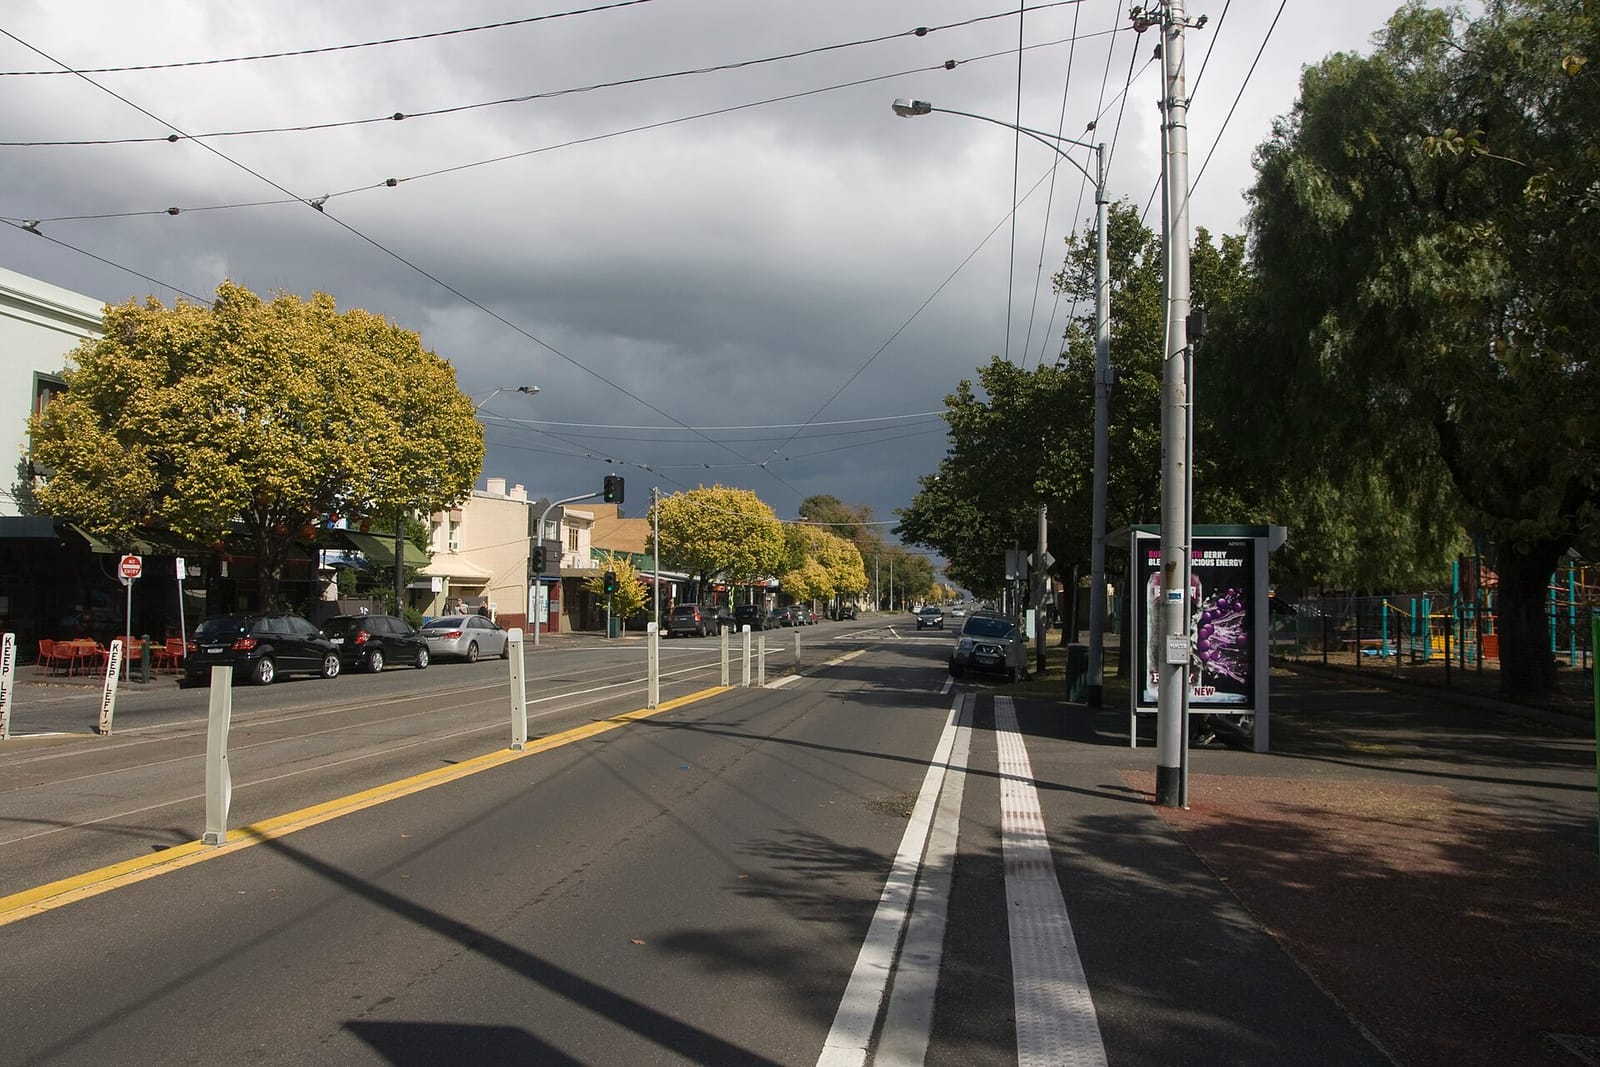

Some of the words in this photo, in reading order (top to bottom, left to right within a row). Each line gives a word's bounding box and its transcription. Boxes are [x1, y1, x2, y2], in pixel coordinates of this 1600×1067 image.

[1203, 551, 1228, 559] BERRY
[1215, 558, 1243, 567] ENERGY
[2, 637, 12, 676] KEEP
[108, 643, 119, 679] KEEP
[103, 683, 112, 719] LEFT
[1194, 687, 1215, 696] NEW
